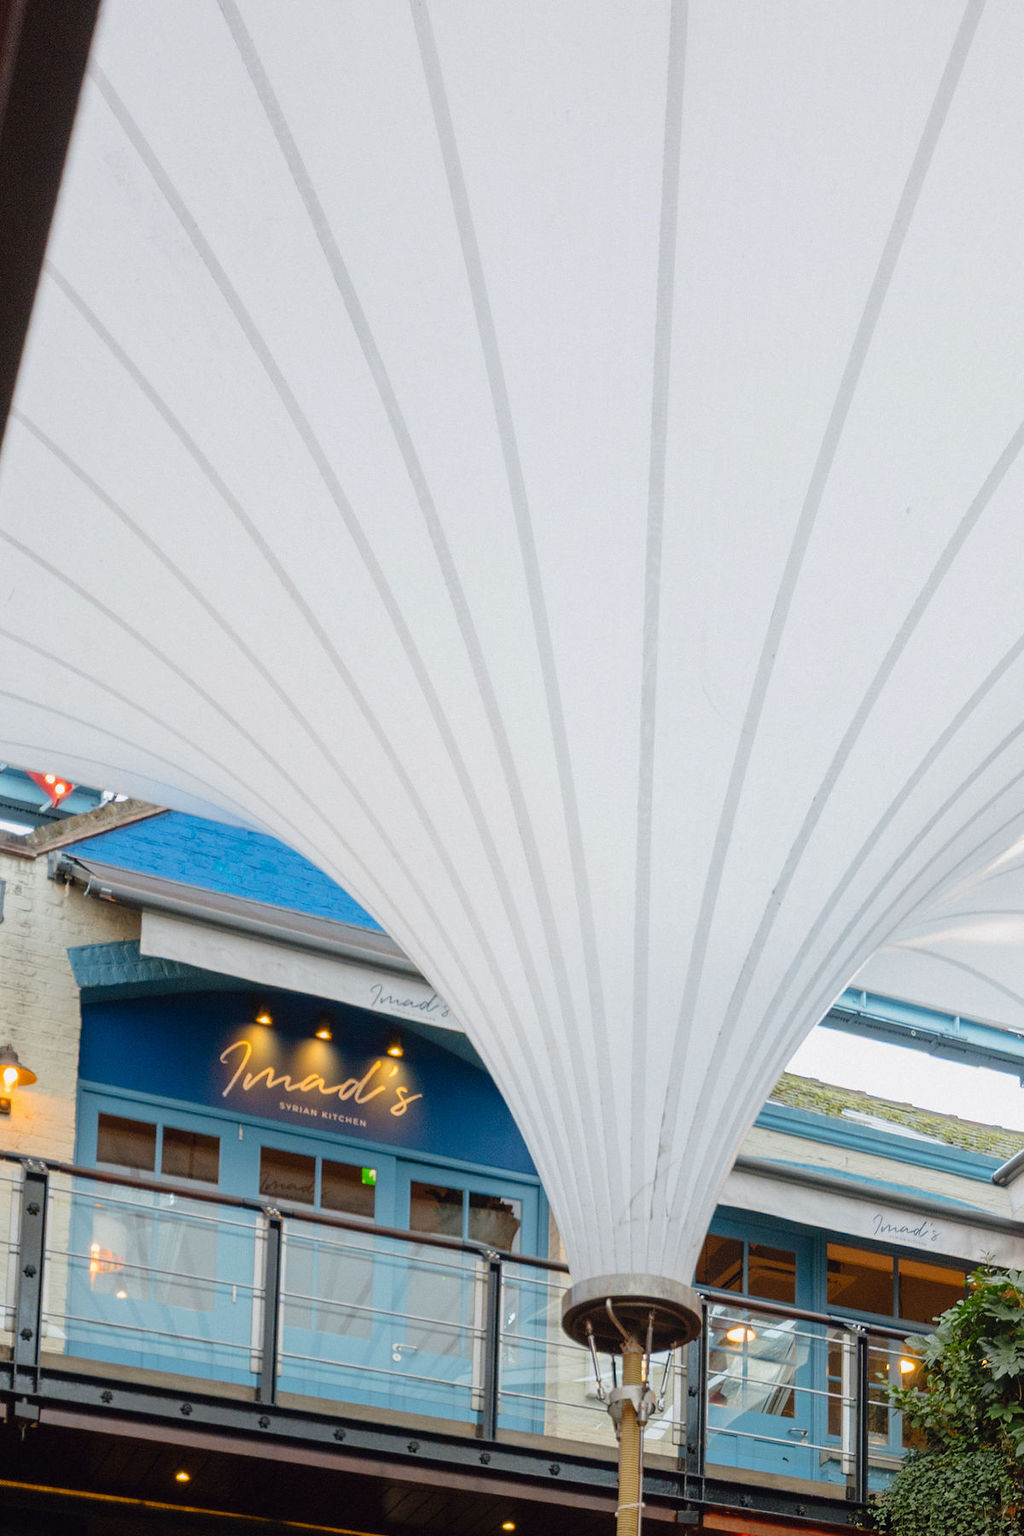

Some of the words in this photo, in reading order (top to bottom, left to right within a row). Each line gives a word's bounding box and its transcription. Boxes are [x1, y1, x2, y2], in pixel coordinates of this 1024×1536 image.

[370, 983, 450, 1018] Imad's
[220, 1040, 423, 1117] Imad's
[279, 1101, 318, 1117] SYRIAN
[321, 1111, 367, 1128] KITCHEN
[873, 1214, 940, 1241] Imad's
